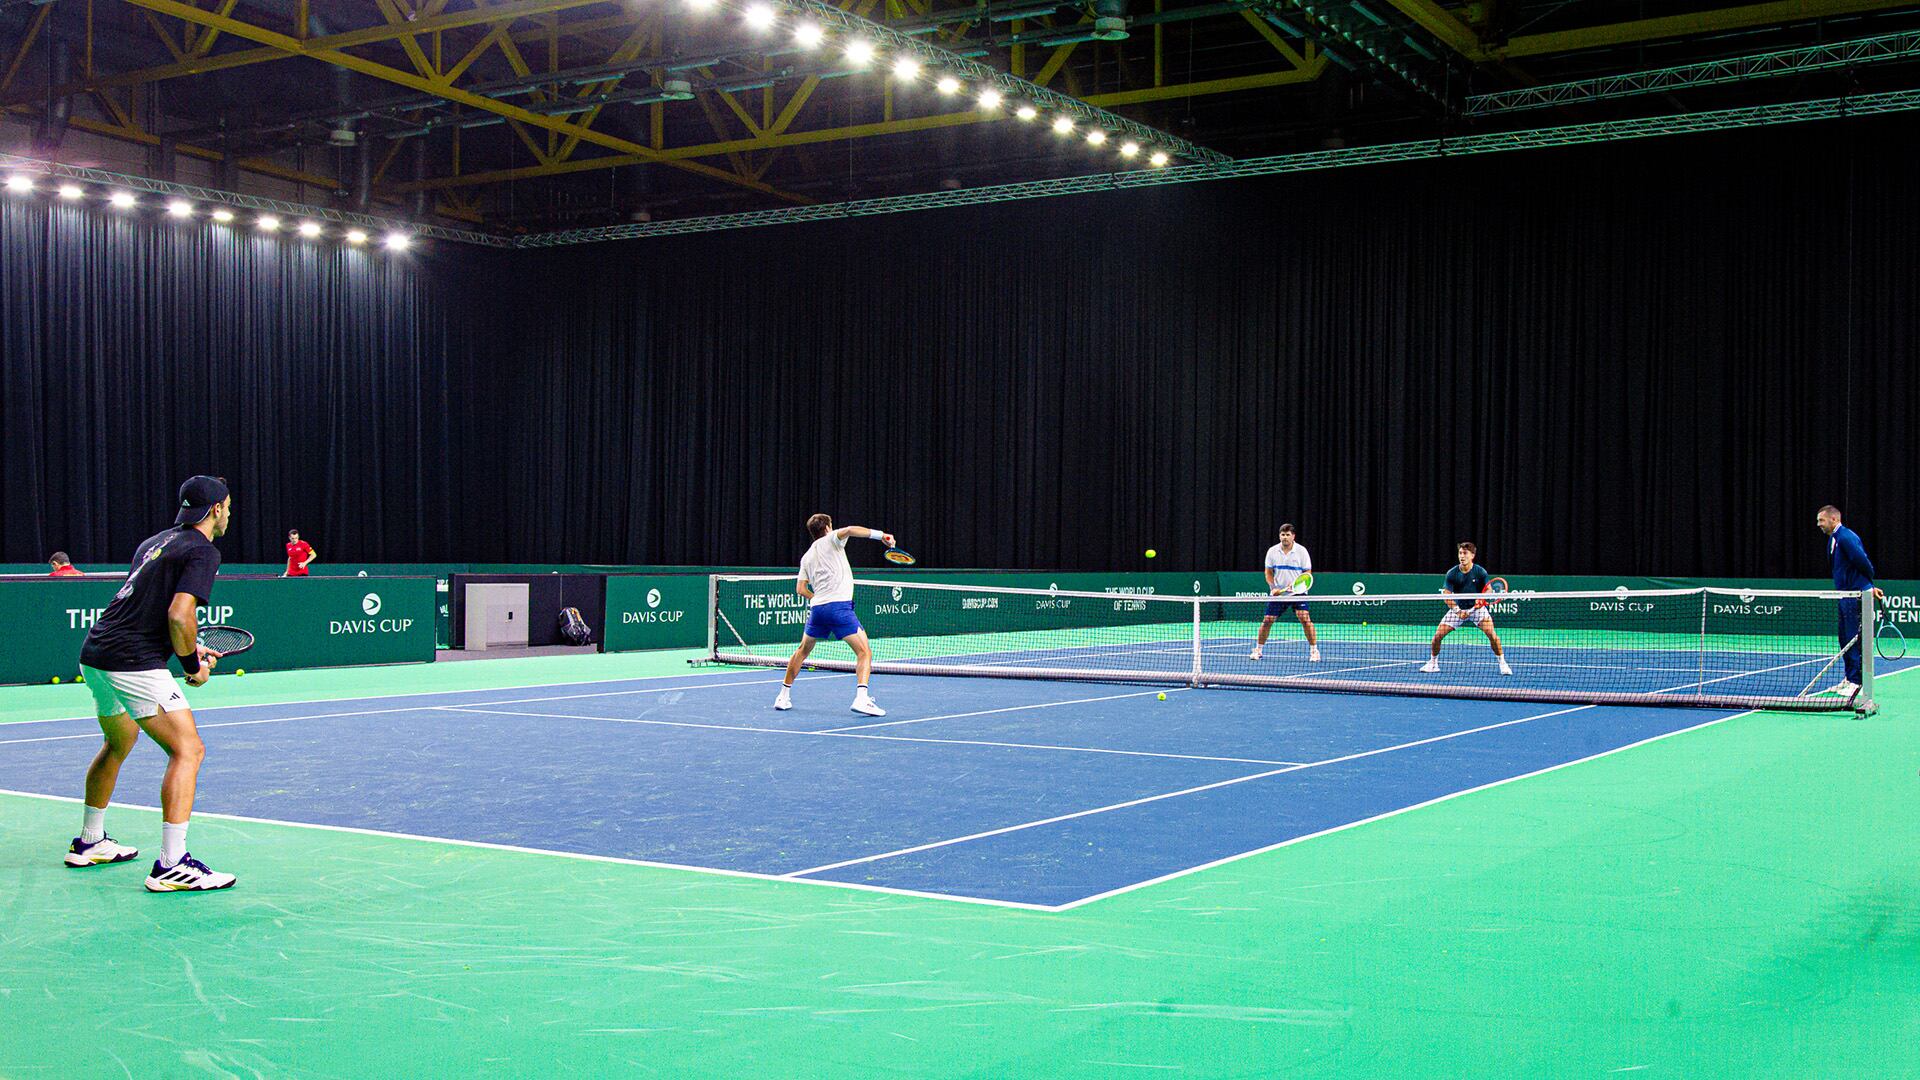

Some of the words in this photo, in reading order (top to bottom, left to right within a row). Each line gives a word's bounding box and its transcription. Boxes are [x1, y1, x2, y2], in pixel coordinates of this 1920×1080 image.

[744, 594, 766, 609] THE
[767, 594, 805, 608] WORLD
[1035, 600, 1056, 610] DAVIS
[1056, 599, 1071, 609] CUP
[1113, 600, 1122, 611] OF
[1590, 601, 1625, 611] DAVIS
[1628, 602, 1655, 612] CUP
[875, 604, 900, 615] DAVIS
[901, 603, 919, 614] CUP
[1489, 603, 1518, 614] NNIS
[1713, 604, 1751, 615] DAVIS
[1754, 605, 1783, 615] CUP
[195, 605, 234, 625] CUP
[623, 611, 657, 624] DAVIS
[659, 610, 683, 623] CUP
[758, 611, 773, 625] OF
[1889, 610, 1920, 623] TEN
[329, 620, 376, 635] DAVIS
[379, 619, 413, 633] CUP
